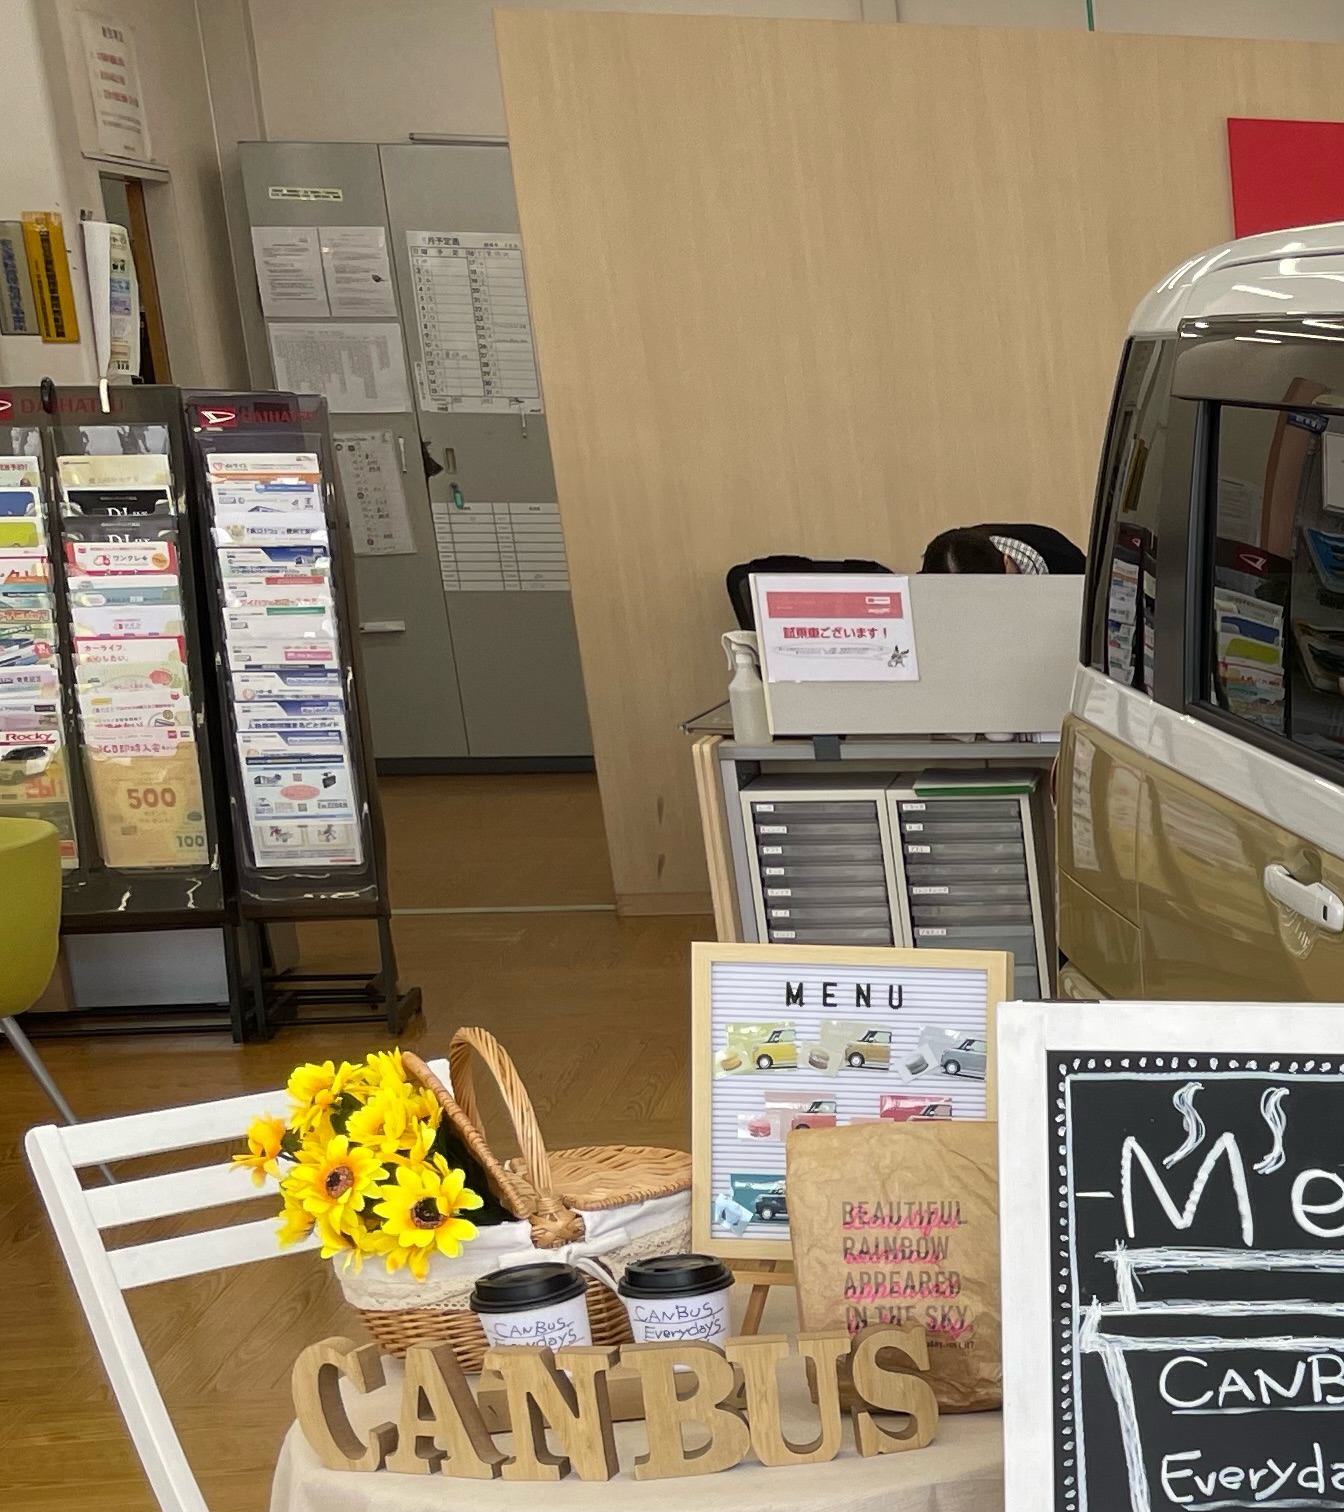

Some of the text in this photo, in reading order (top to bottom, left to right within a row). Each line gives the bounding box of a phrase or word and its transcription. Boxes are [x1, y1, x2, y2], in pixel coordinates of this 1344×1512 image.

[6, 732, 53, 742] Rocky
[127, 787, 177, 810] 500
[176, 836, 205, 848] 100
[786, 981, 903, 1010] MENU
[841, 1201, 968, 1226] BEAUTIFUL
[842, 1235, 950, 1261] RAINBOW
[844, 1270, 962, 1296] APPEARED
[845, 1305, 868, 1330] IN
[925, 1305, 970, 1330] SKY
[292, 1323, 940, 1481] CANBUS
